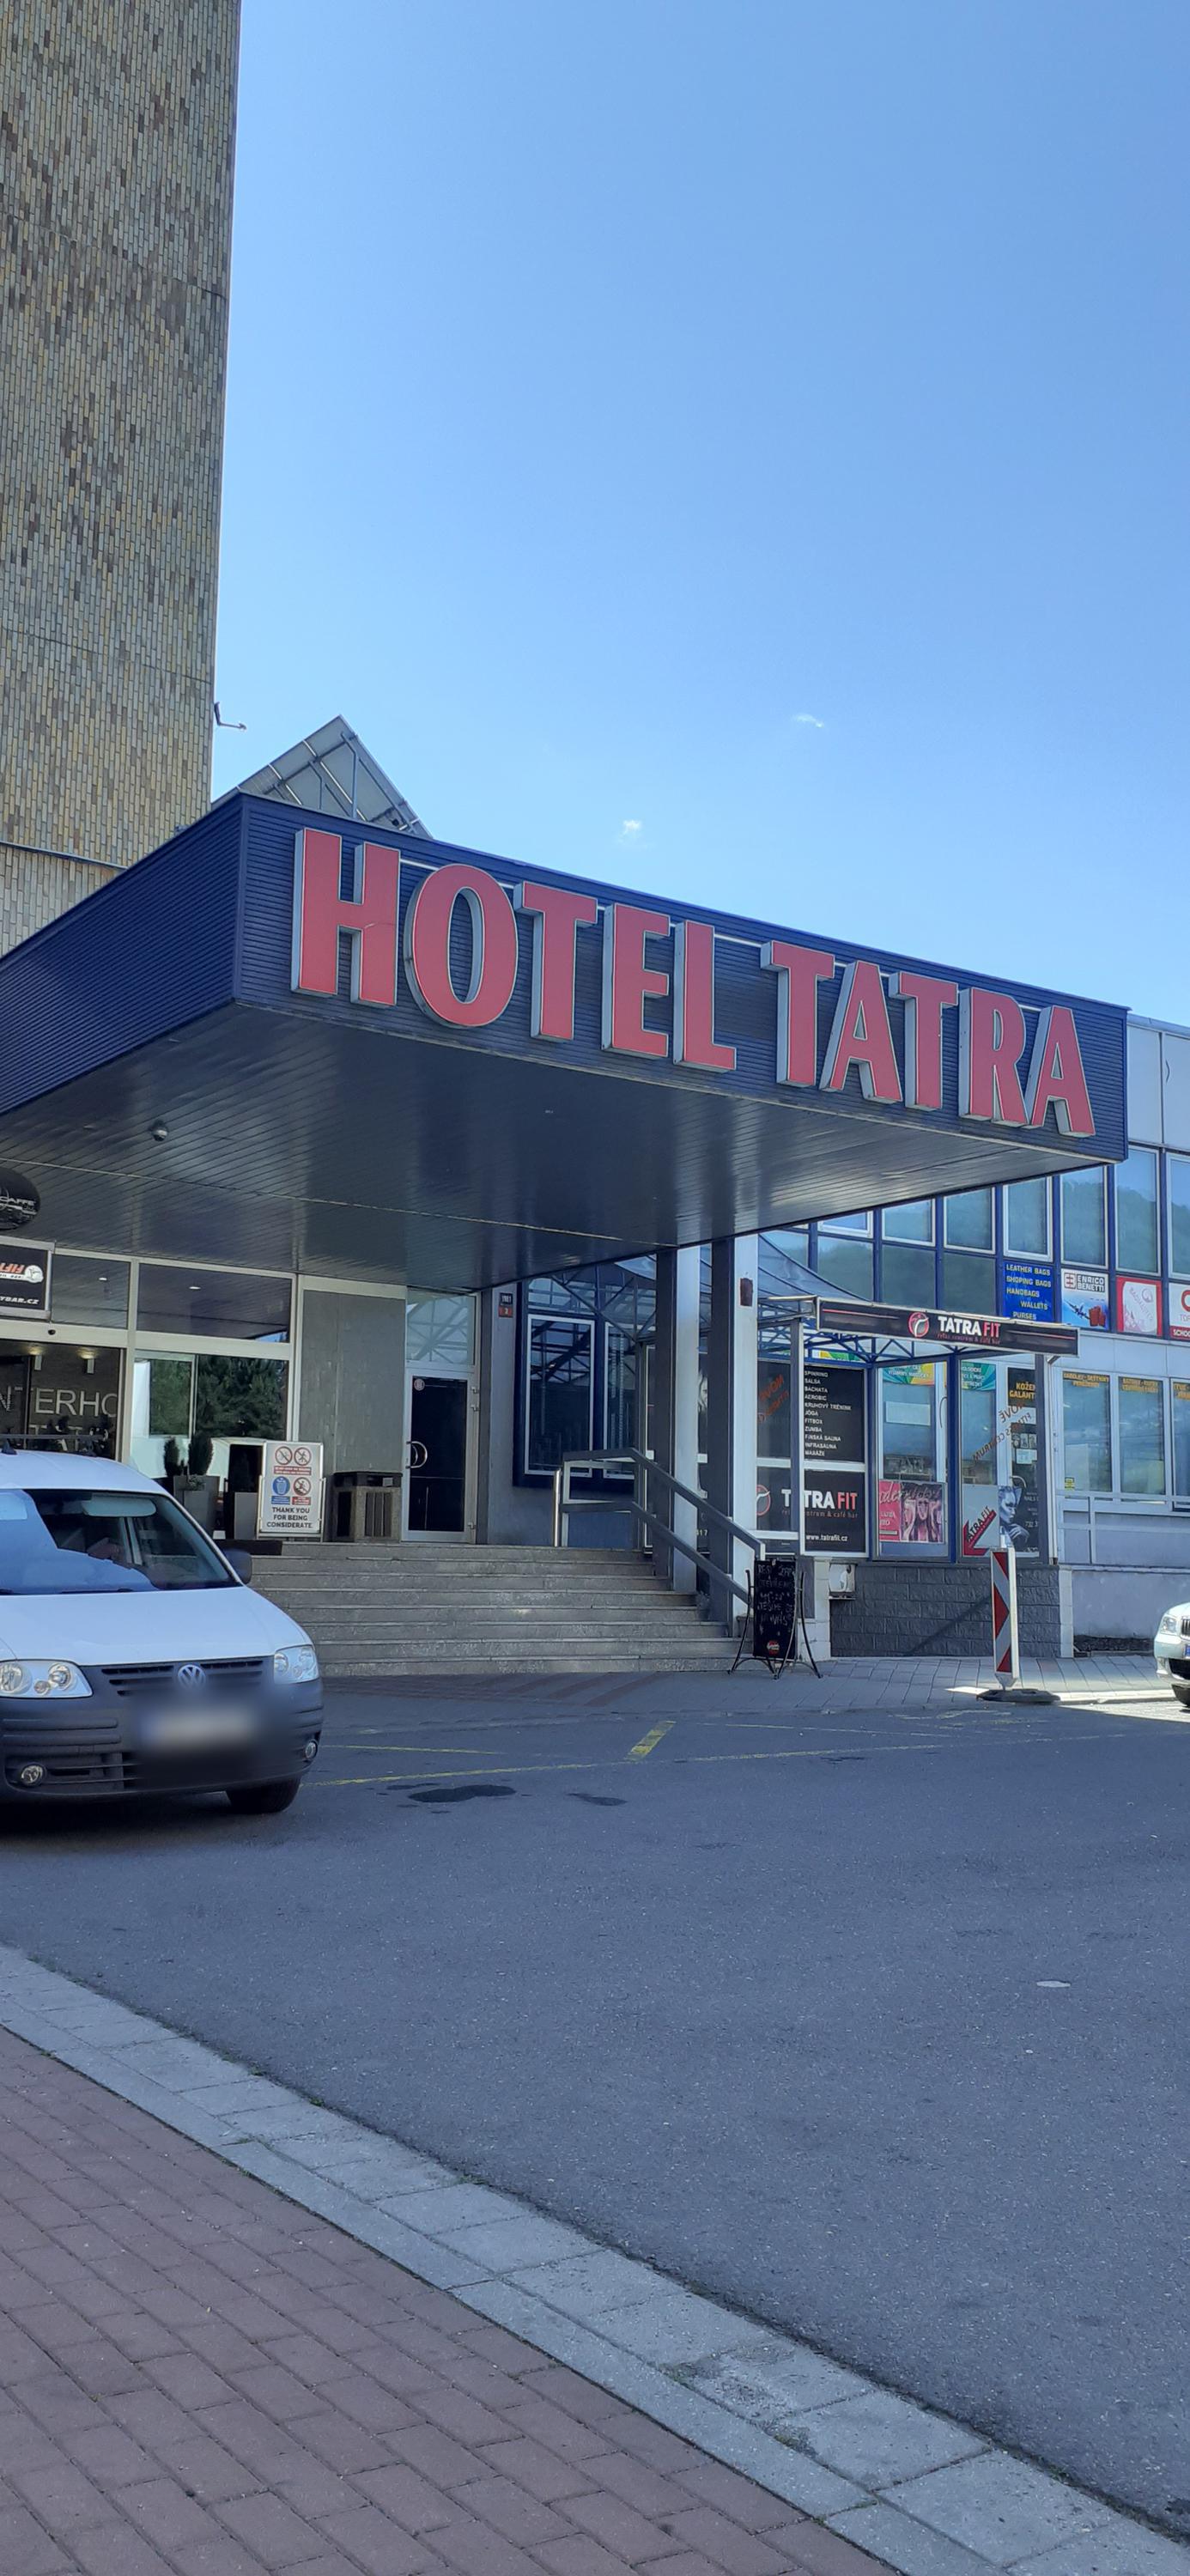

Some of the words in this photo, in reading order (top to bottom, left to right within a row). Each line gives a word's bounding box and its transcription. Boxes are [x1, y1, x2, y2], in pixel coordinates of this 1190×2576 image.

[291, 828, 738, 1072] HOTEL
[761, 939, 1096, 1138] TATRA
[1006, 1264, 1033, 1273] LEATHER
[1034, 1267, 1050, 1276] BAGS
[1078, 1274, 1104, 1285] ENRICO
[1006, 1287, 1040, 1297] HANDBAGS
[1078, 1283, 1105, 1292] BENETTI
[1020, 1300, 1048, 1310] WALLETS
[1013, 1311, 1036, 1320] PURSES
[938, 1315, 982, 1336] TATRA
[983, 1321, 1001, 1338] FIT
[781, 1488, 835, 1509] TTRA
[837, 1492, 858, 1510] FIT
